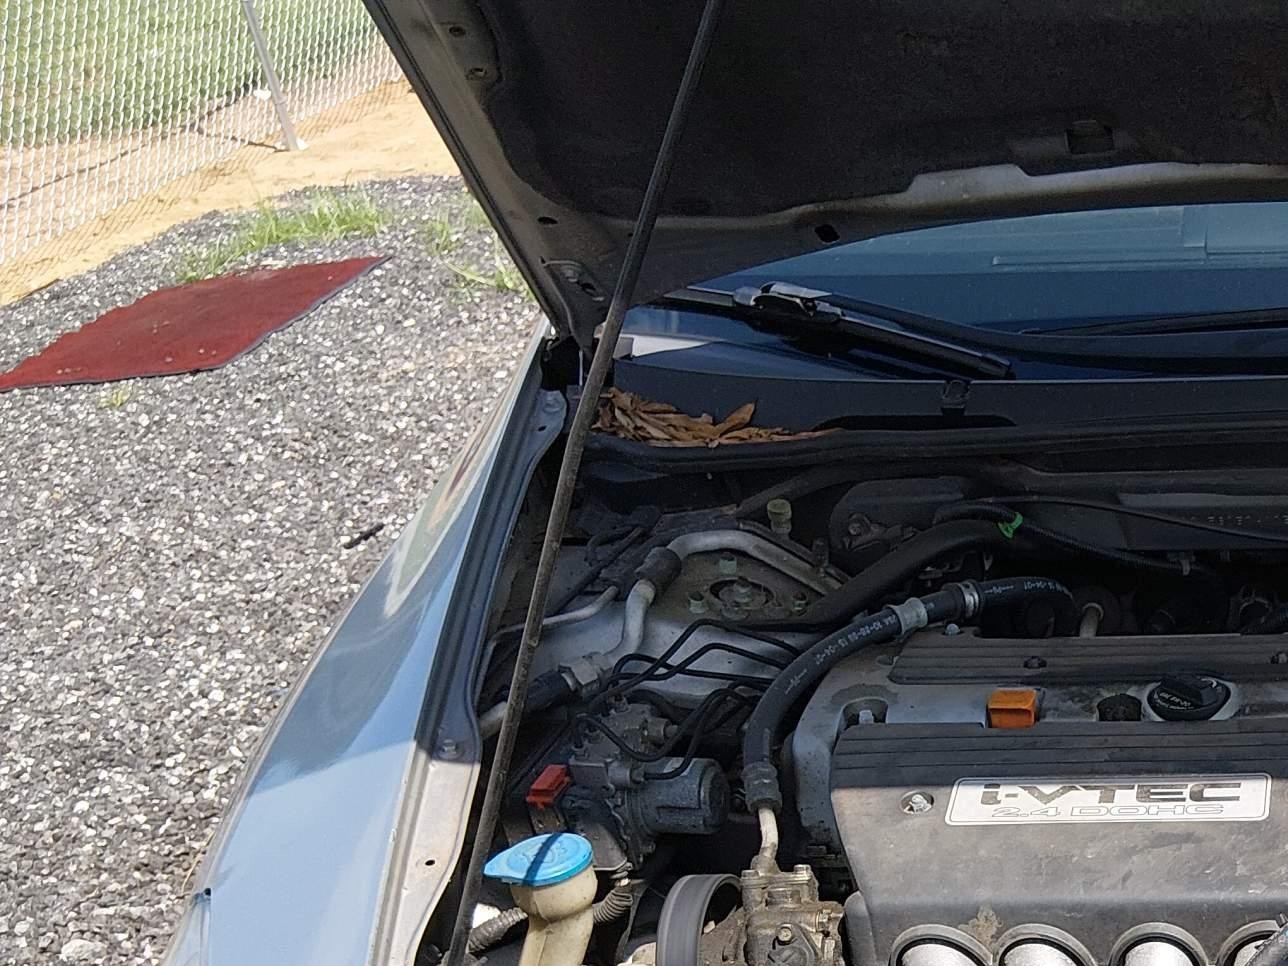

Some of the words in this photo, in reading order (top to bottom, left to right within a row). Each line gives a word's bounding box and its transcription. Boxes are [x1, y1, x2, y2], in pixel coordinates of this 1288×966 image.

[981, 782, 1241, 805] i-VTEC
[991, 806, 1062, 818] 2.4
[1070, 803, 1225, 817] DOHC
